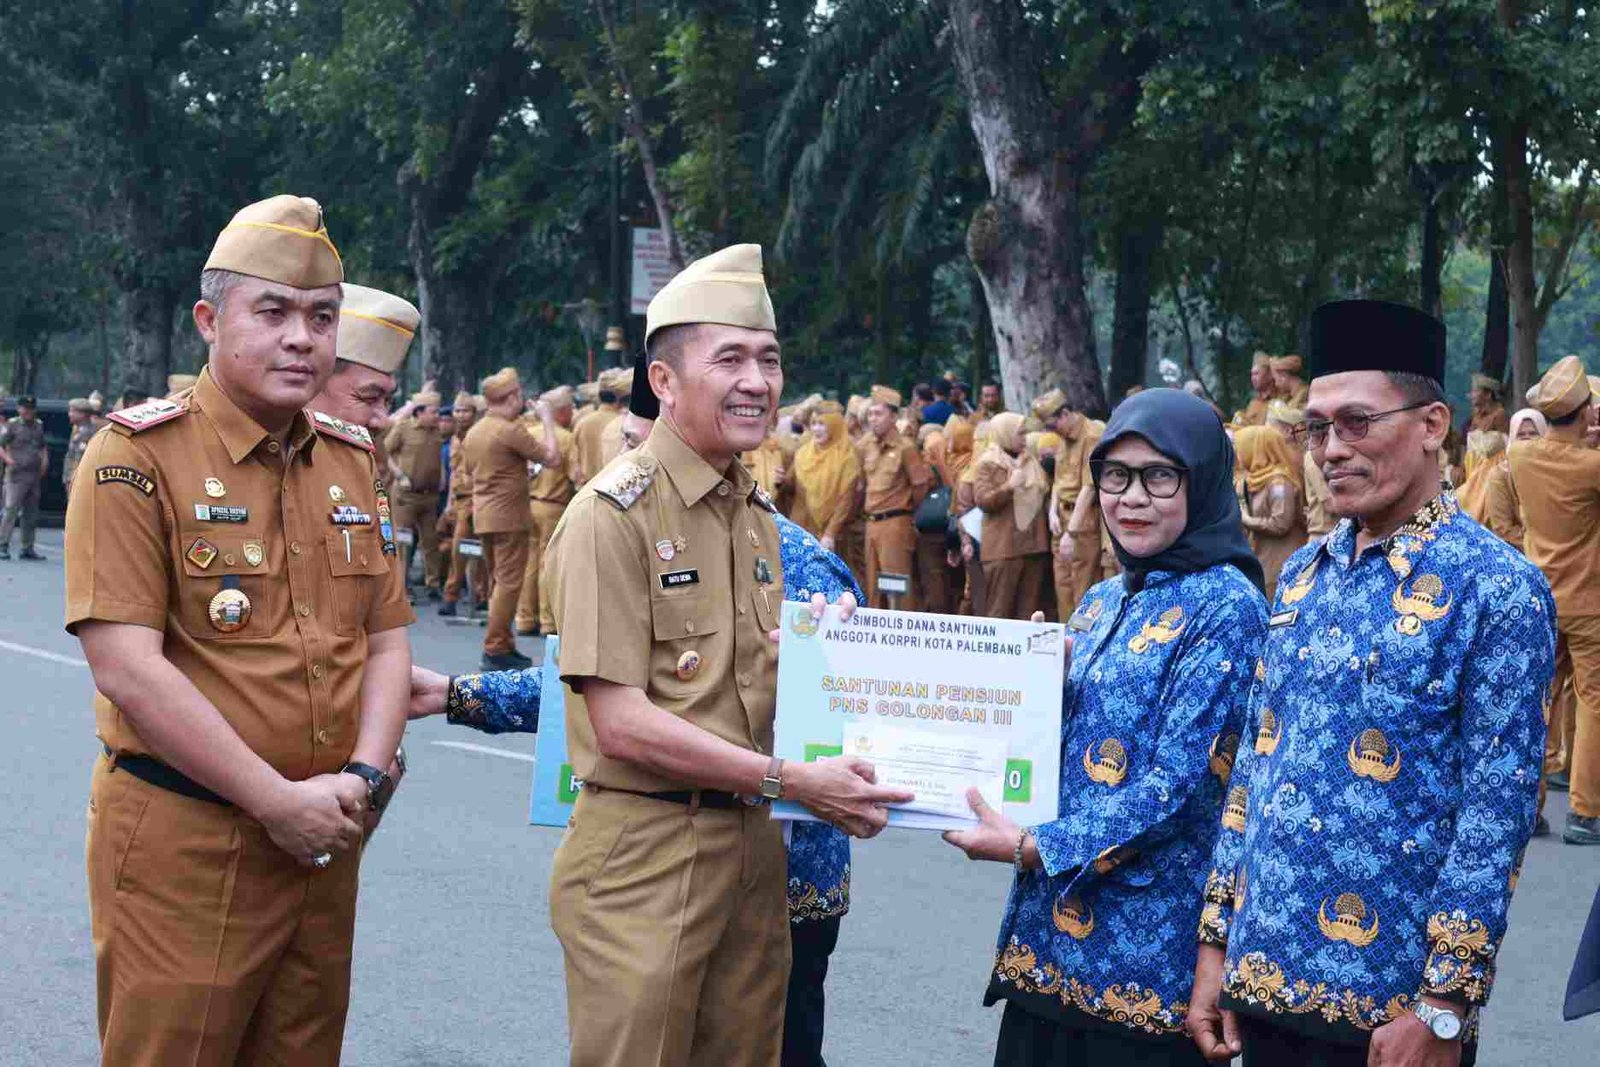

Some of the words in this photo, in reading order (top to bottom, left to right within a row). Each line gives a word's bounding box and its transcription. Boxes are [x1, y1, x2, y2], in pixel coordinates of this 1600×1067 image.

[852, 614, 903, 629] SIMBOLIS
[906, 618, 936, 632] DANA
[940, 621, 996, 637] SANTUNAN
[825, 629, 878, 644] ANGGOTA
[881, 633, 921, 648] KORPRI
[925, 637, 953, 650] KOTA
[957, 640, 1022, 656] PALEMBANG
[821, 675, 929, 698] SANTUNAN
[936, 684, 1021, 706] PENSIUN
[829, 696, 869, 714] PNS
[875, 699, 986, 724] GOLONGAN
[993, 709, 1012, 725] III
